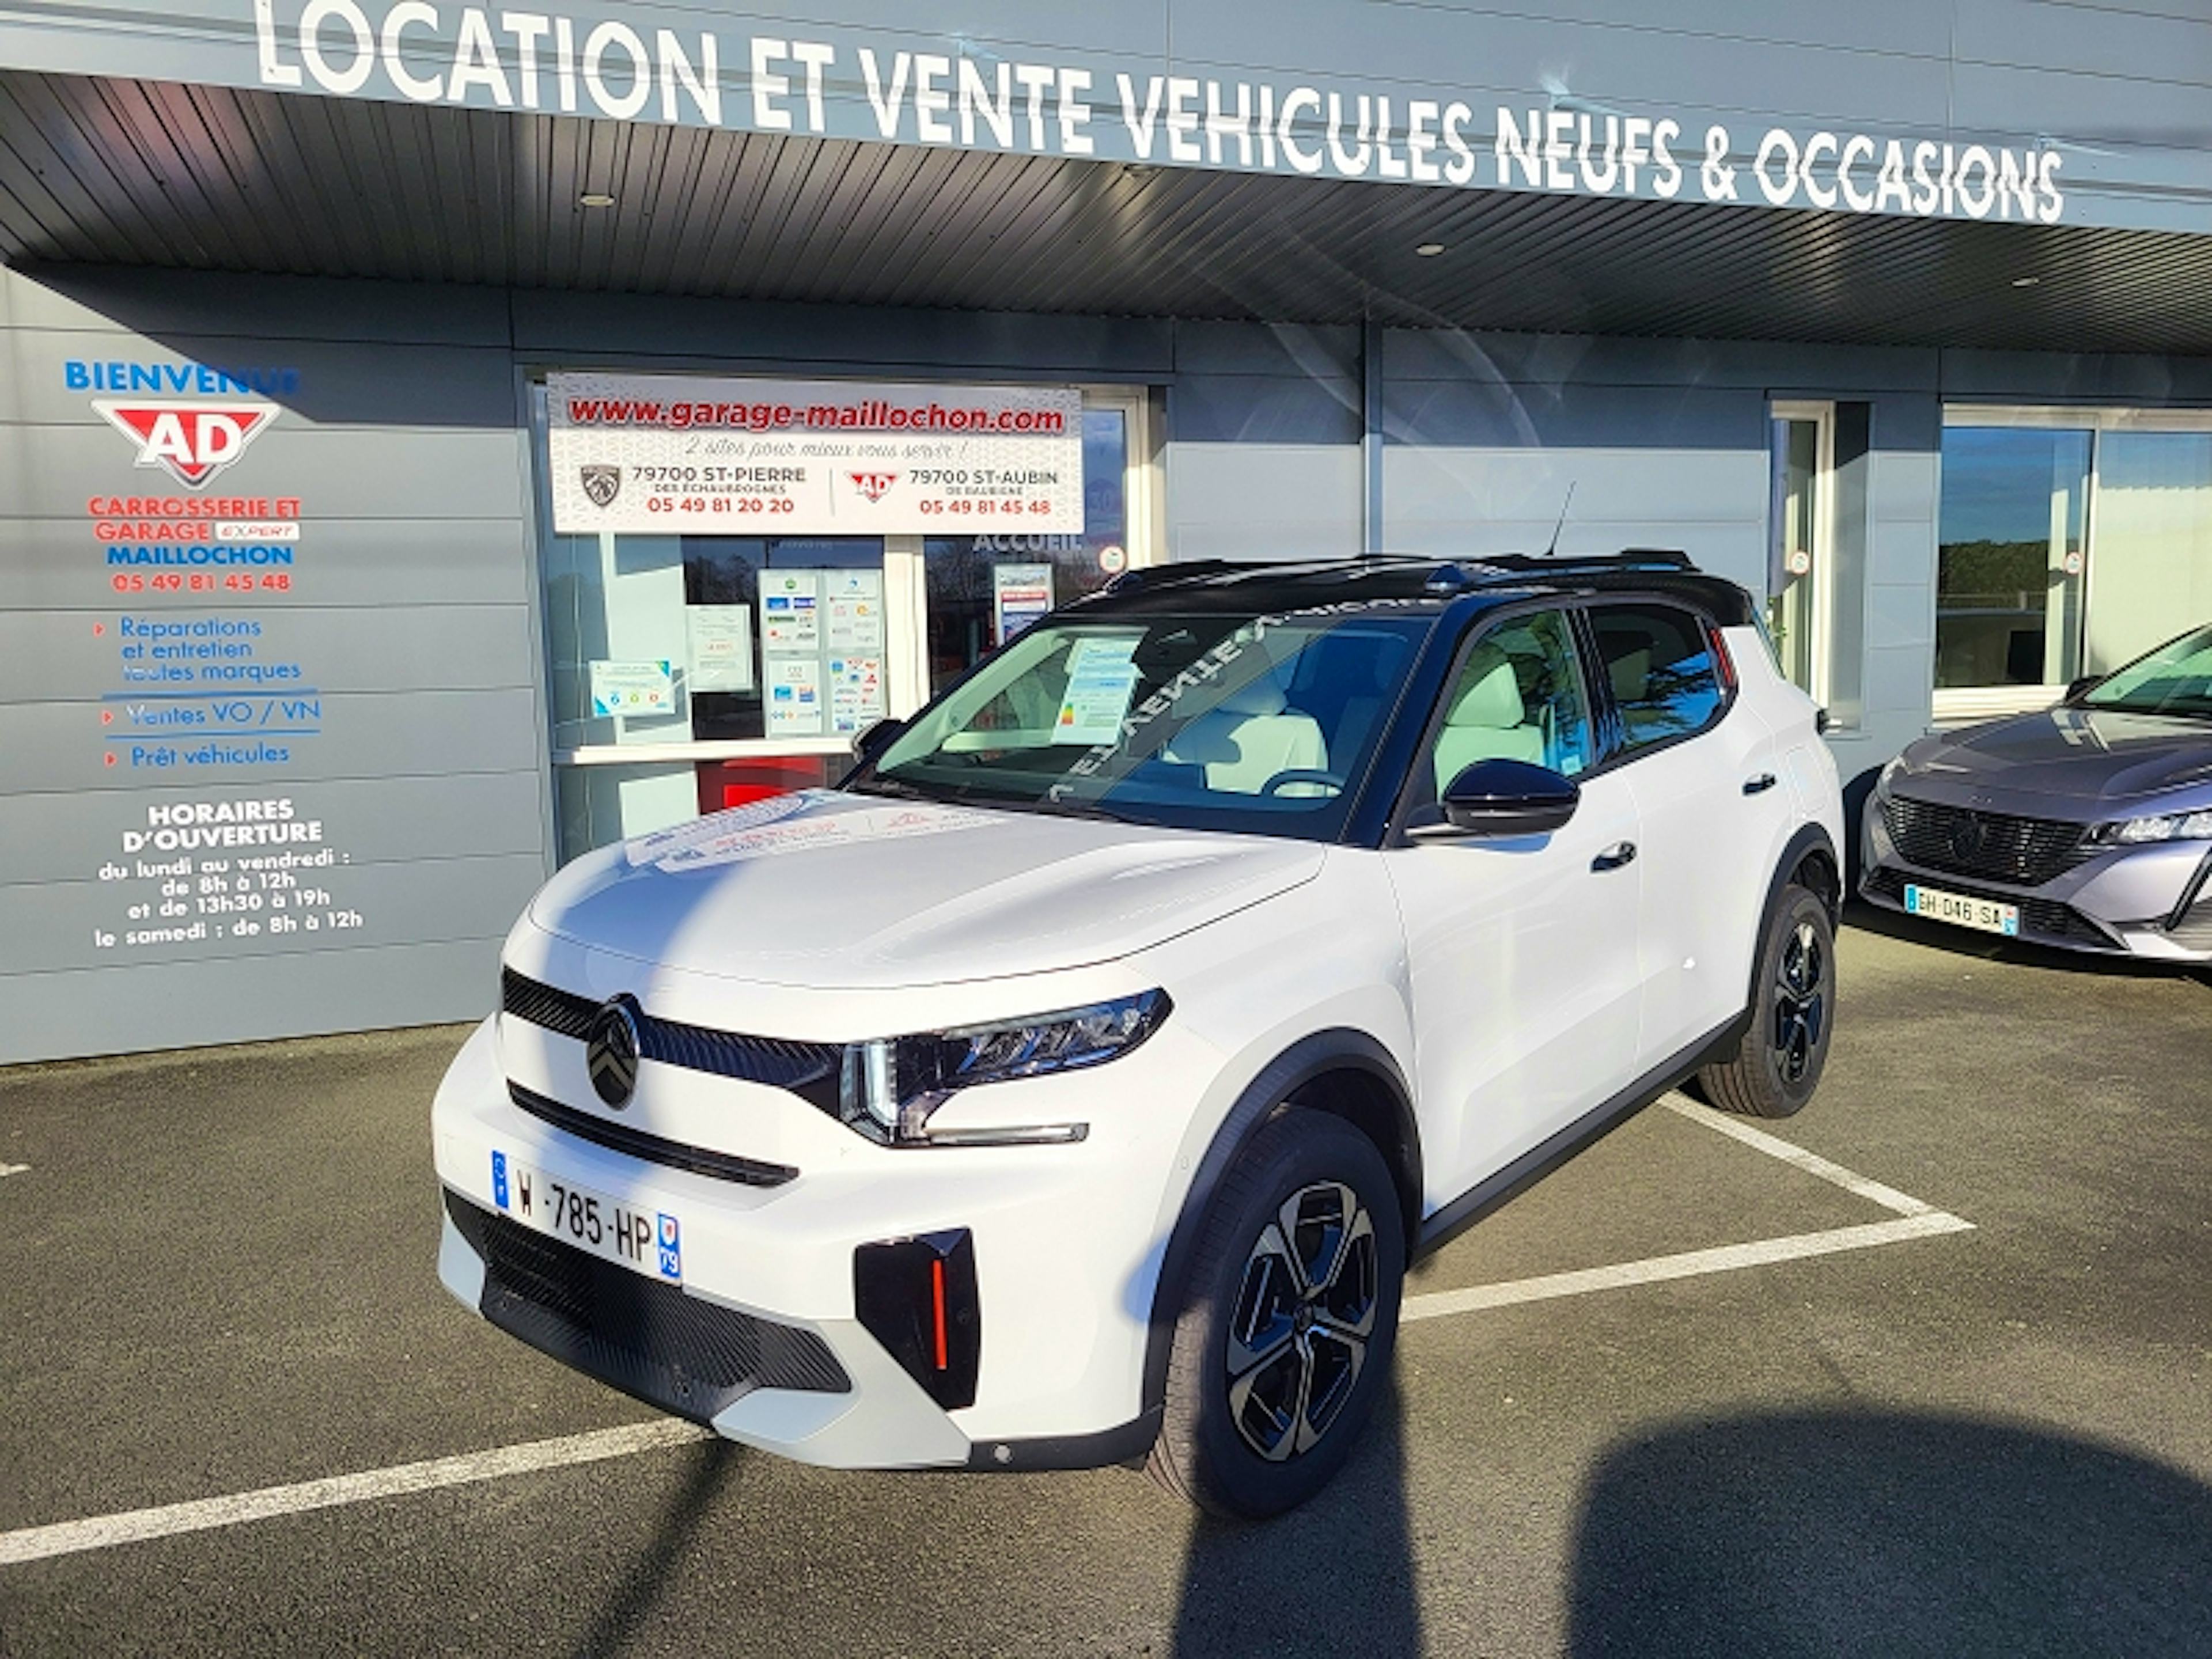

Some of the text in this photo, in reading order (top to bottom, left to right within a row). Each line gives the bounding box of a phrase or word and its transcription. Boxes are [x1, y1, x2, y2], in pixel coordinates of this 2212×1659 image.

[253, 0, 2064, 225] LOCATION ET VENTE VEHICULES NEUFS & OCCASIONS
[65, 361, 300, 394] BIENVENUE
[569, 399, 1064, 433] www.garage-maillochon.com
[138, 412, 243, 465] AD
[632, 467, 806, 482] 79700 ST-PIERRE
[909, 469, 1058, 484] 79700 ST-AUBIN
[89, 498, 300, 517] CARROSSERIE ET
[647, 497, 794, 513] 05 49 81 20 20
[920, 499, 1051, 514] 05 49 81 45 48
[94, 522, 295, 541] GARAGE EXPERT
[972, 534, 1083, 552] ACCUEIL
[107, 546, 293, 566] MAILLOCHON
[112, 574, 291, 591] 05 49 81 45 48
[120, 616, 263, 641] Réparations
[122, 638, 252, 660] et entretien
[123, 662, 301, 684] toutes marques
[126, 699, 322, 725] Ventes VO / VN
[131, 741, 290, 768] Prêt véhicules
[147, 798, 294, 827] HORAIRES
[122, 821, 323, 853] D'OUVERTURE
[99, 862, 128, 880] du
[137, 858, 192, 878] lundi
[200, 861, 229, 873] au
[237, 849, 334, 870] vendredi
[161, 872, 297, 897] de 8h à 12h
[127, 889, 331, 919] et de 13h30 à 19h
[95, 930, 116, 948] le
[126, 924, 207, 945] samedi
[232, 919, 260, 937] de
[270, 916, 297, 934] 8h
[305, 915, 320, 930] à
[327, 910, 363, 929] 12h
